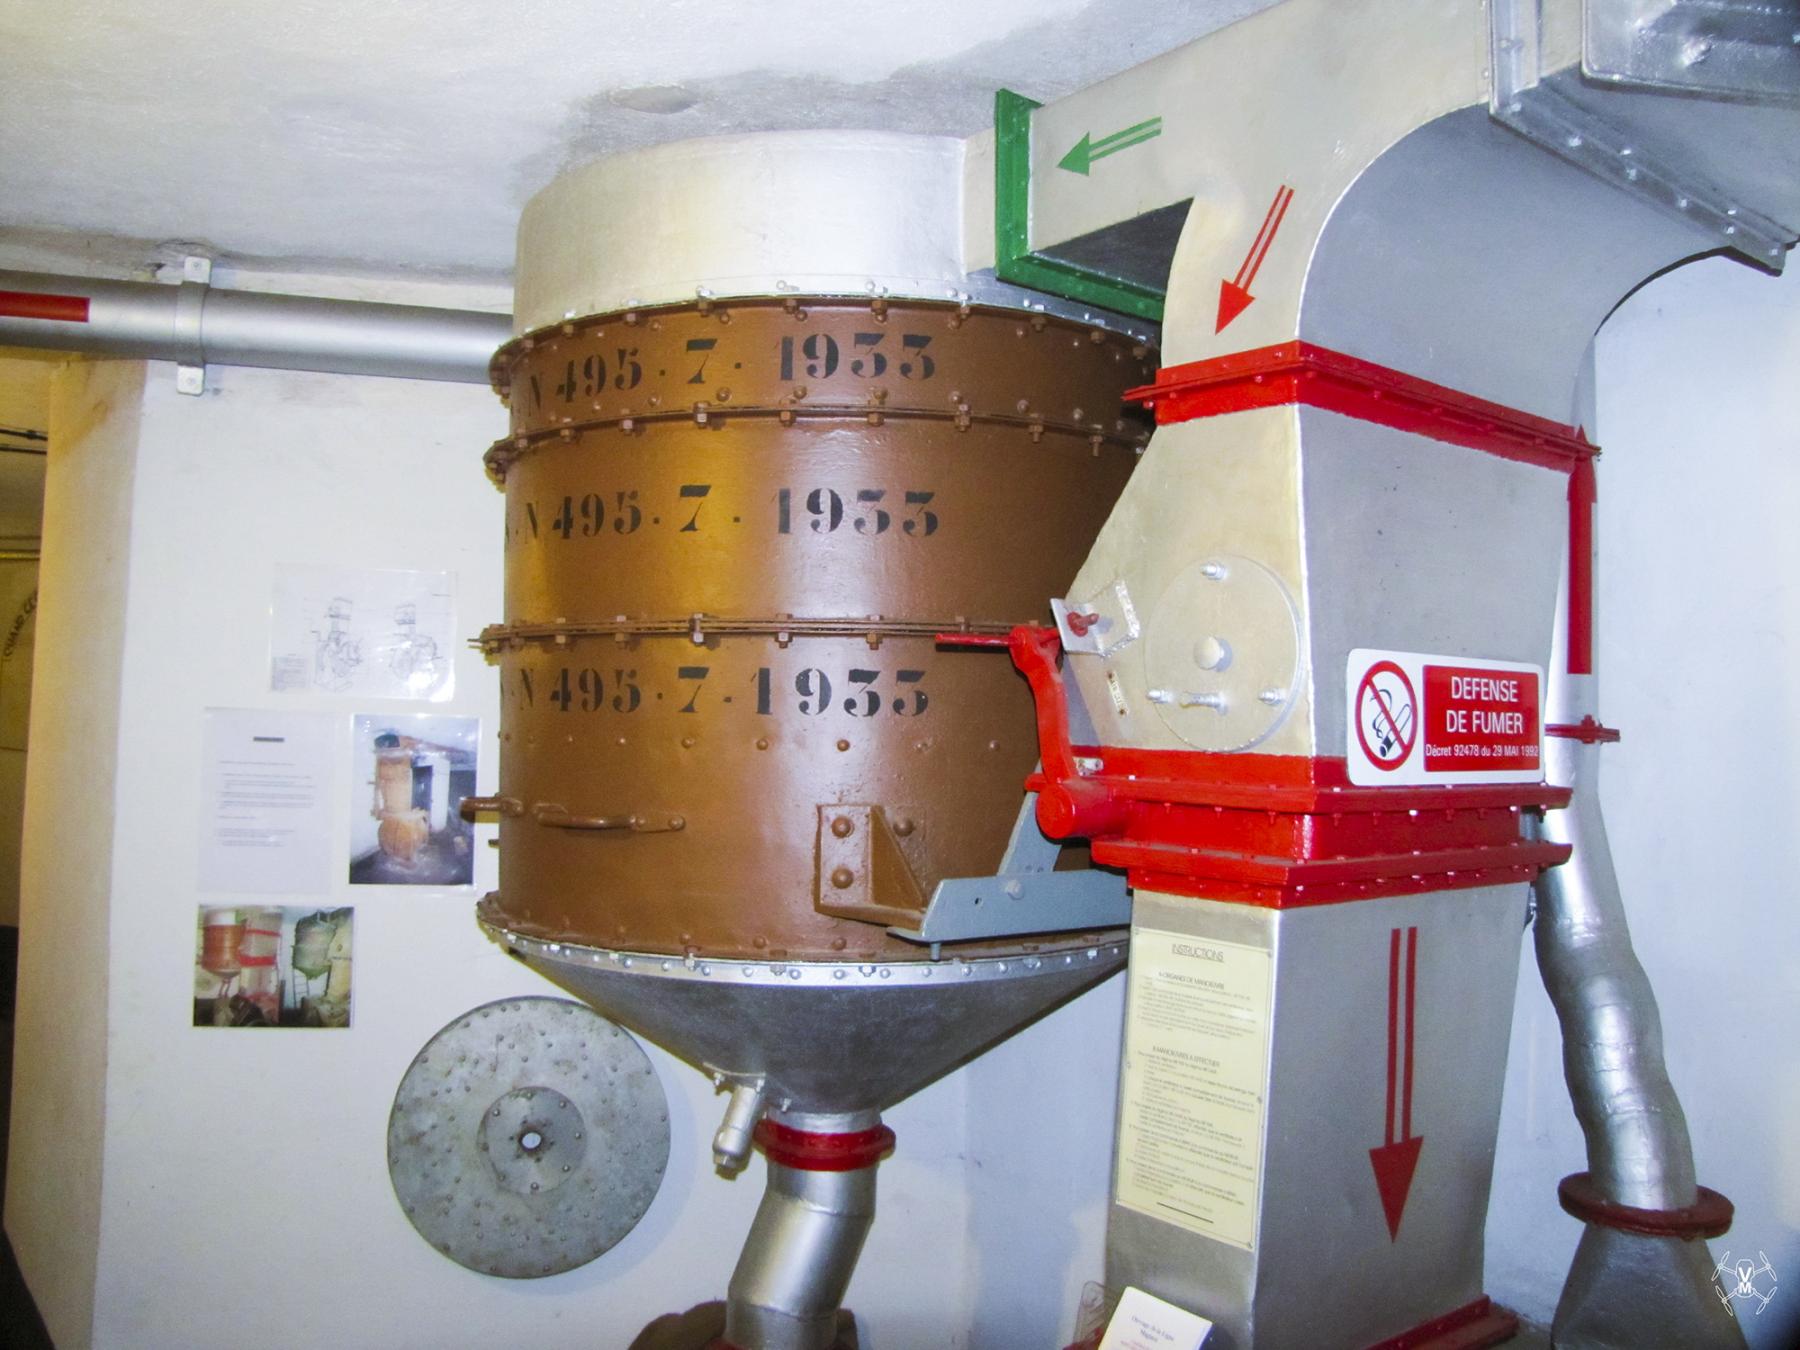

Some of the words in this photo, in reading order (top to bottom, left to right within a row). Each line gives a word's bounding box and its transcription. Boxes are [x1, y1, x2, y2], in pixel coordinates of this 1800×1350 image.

[556, 346, 642, 403] 495
[686, 337, 718, 384] 7
[774, 333, 936, 381] 1933
[551, 489, 642, 539] 495
[679, 484, 712, 532] 7
[772, 487, 939, 537] 1933
[550, 667, 642, 713] 495
[677, 667, 709, 713] 7
[750, 667, 929, 716] 1933
[1451, 675, 1518, 702] DEFENSE
[1446, 709, 1467, 733] DE
[1472, 710, 1523, 734] FUMER
[1425, 744, 1451, 757] Décret
[1480, 745, 1490, 756] du
[1492, 744, 1503, 756] 29
[1504, 745, 1519, 756] MAI
[1171, 943, 1224, 962] INSTRUCTIONS
